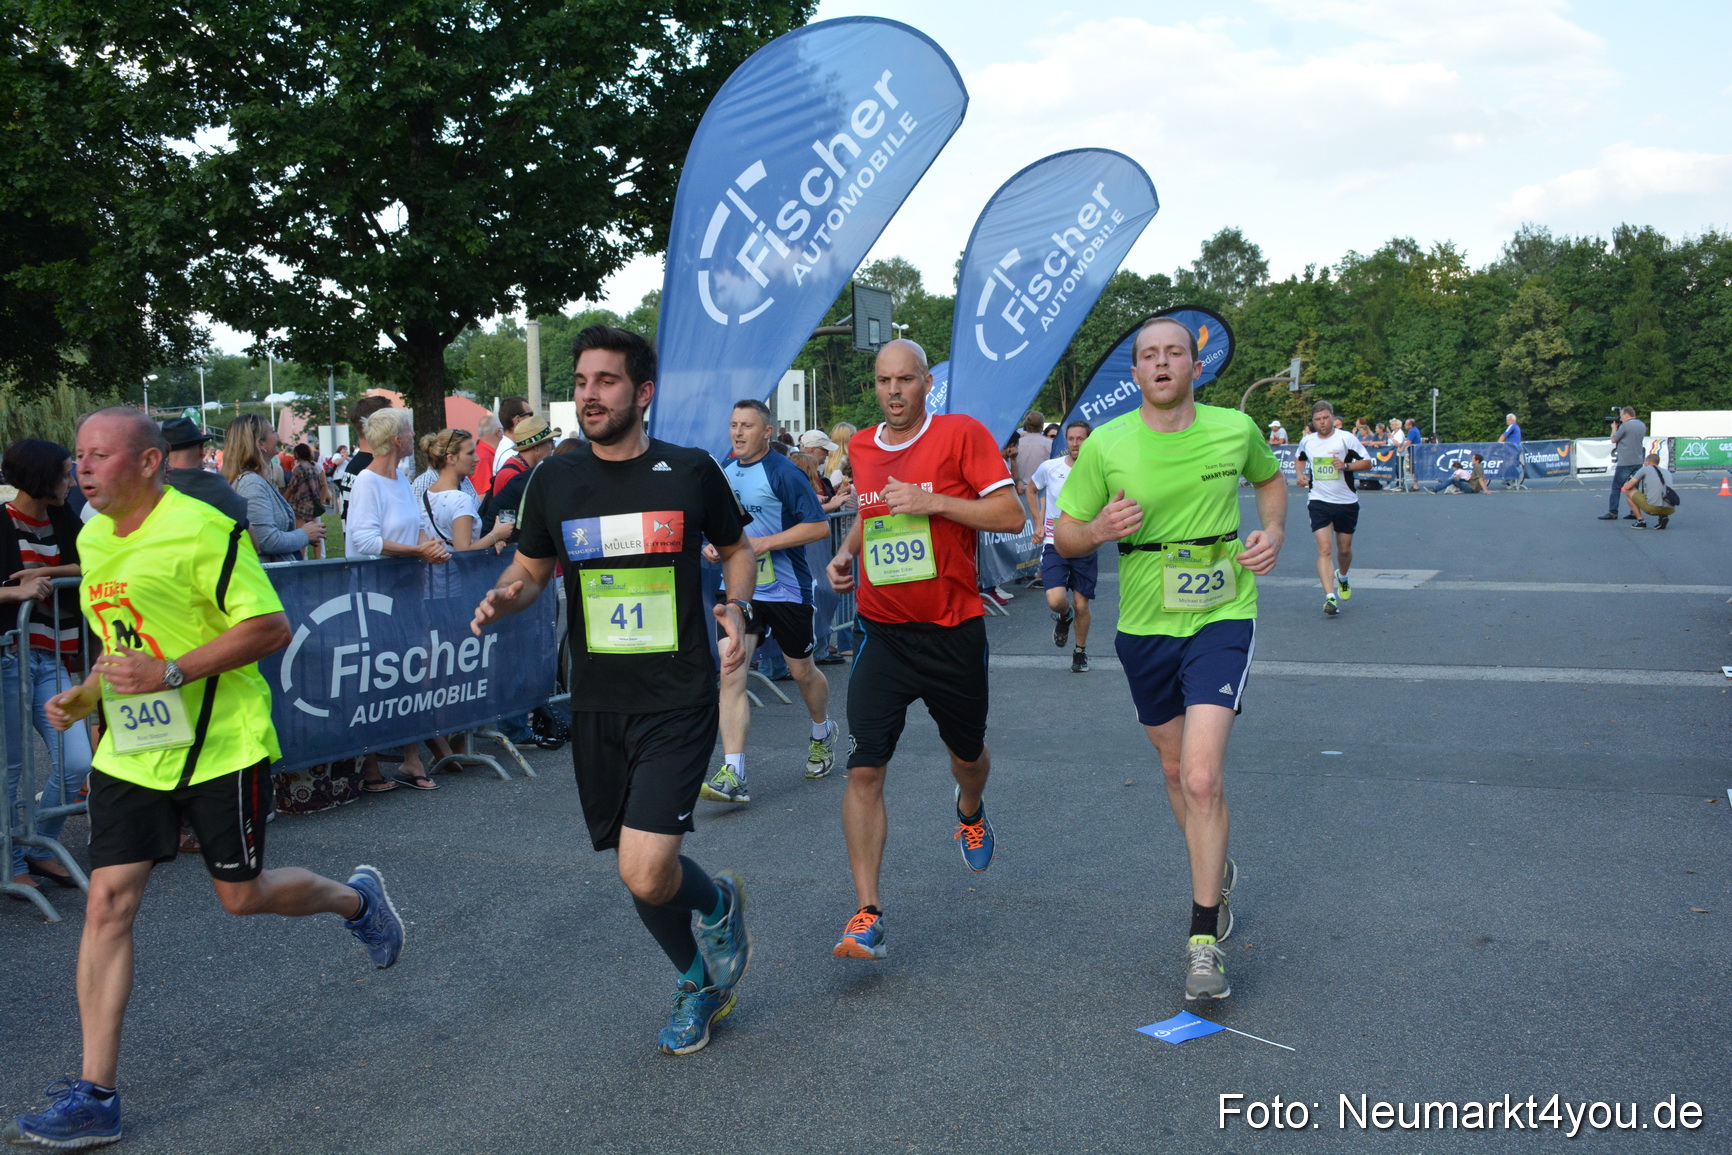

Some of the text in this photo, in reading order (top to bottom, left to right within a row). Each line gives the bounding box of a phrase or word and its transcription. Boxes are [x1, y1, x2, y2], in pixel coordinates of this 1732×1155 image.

[736, 69, 899, 288] Fischer
[792, 111, 918, 287] AUTOMOBILE
[1001, 181, 1111, 335] Fischer
[1040, 209, 1125, 332] AUTOMOBILE
[1080, 379, 1141, 421] Frisch
[1525, 452, 1560, 463] Frischmann
[1681, 442, 1709, 456] AOK
[1317, 466, 1334, 474] 400
[568, 548, 601, 556] PEUGEOT
[604, 538, 641, 551] MÜLLER
[870, 539, 926, 566] 1399
[1177, 570, 1225, 594] 223
[611, 602, 643, 630] 41
[330, 629, 498, 699] Fischer
[120, 700, 171, 731] 340
[349, 679, 488, 728] AUTOMOBILE
